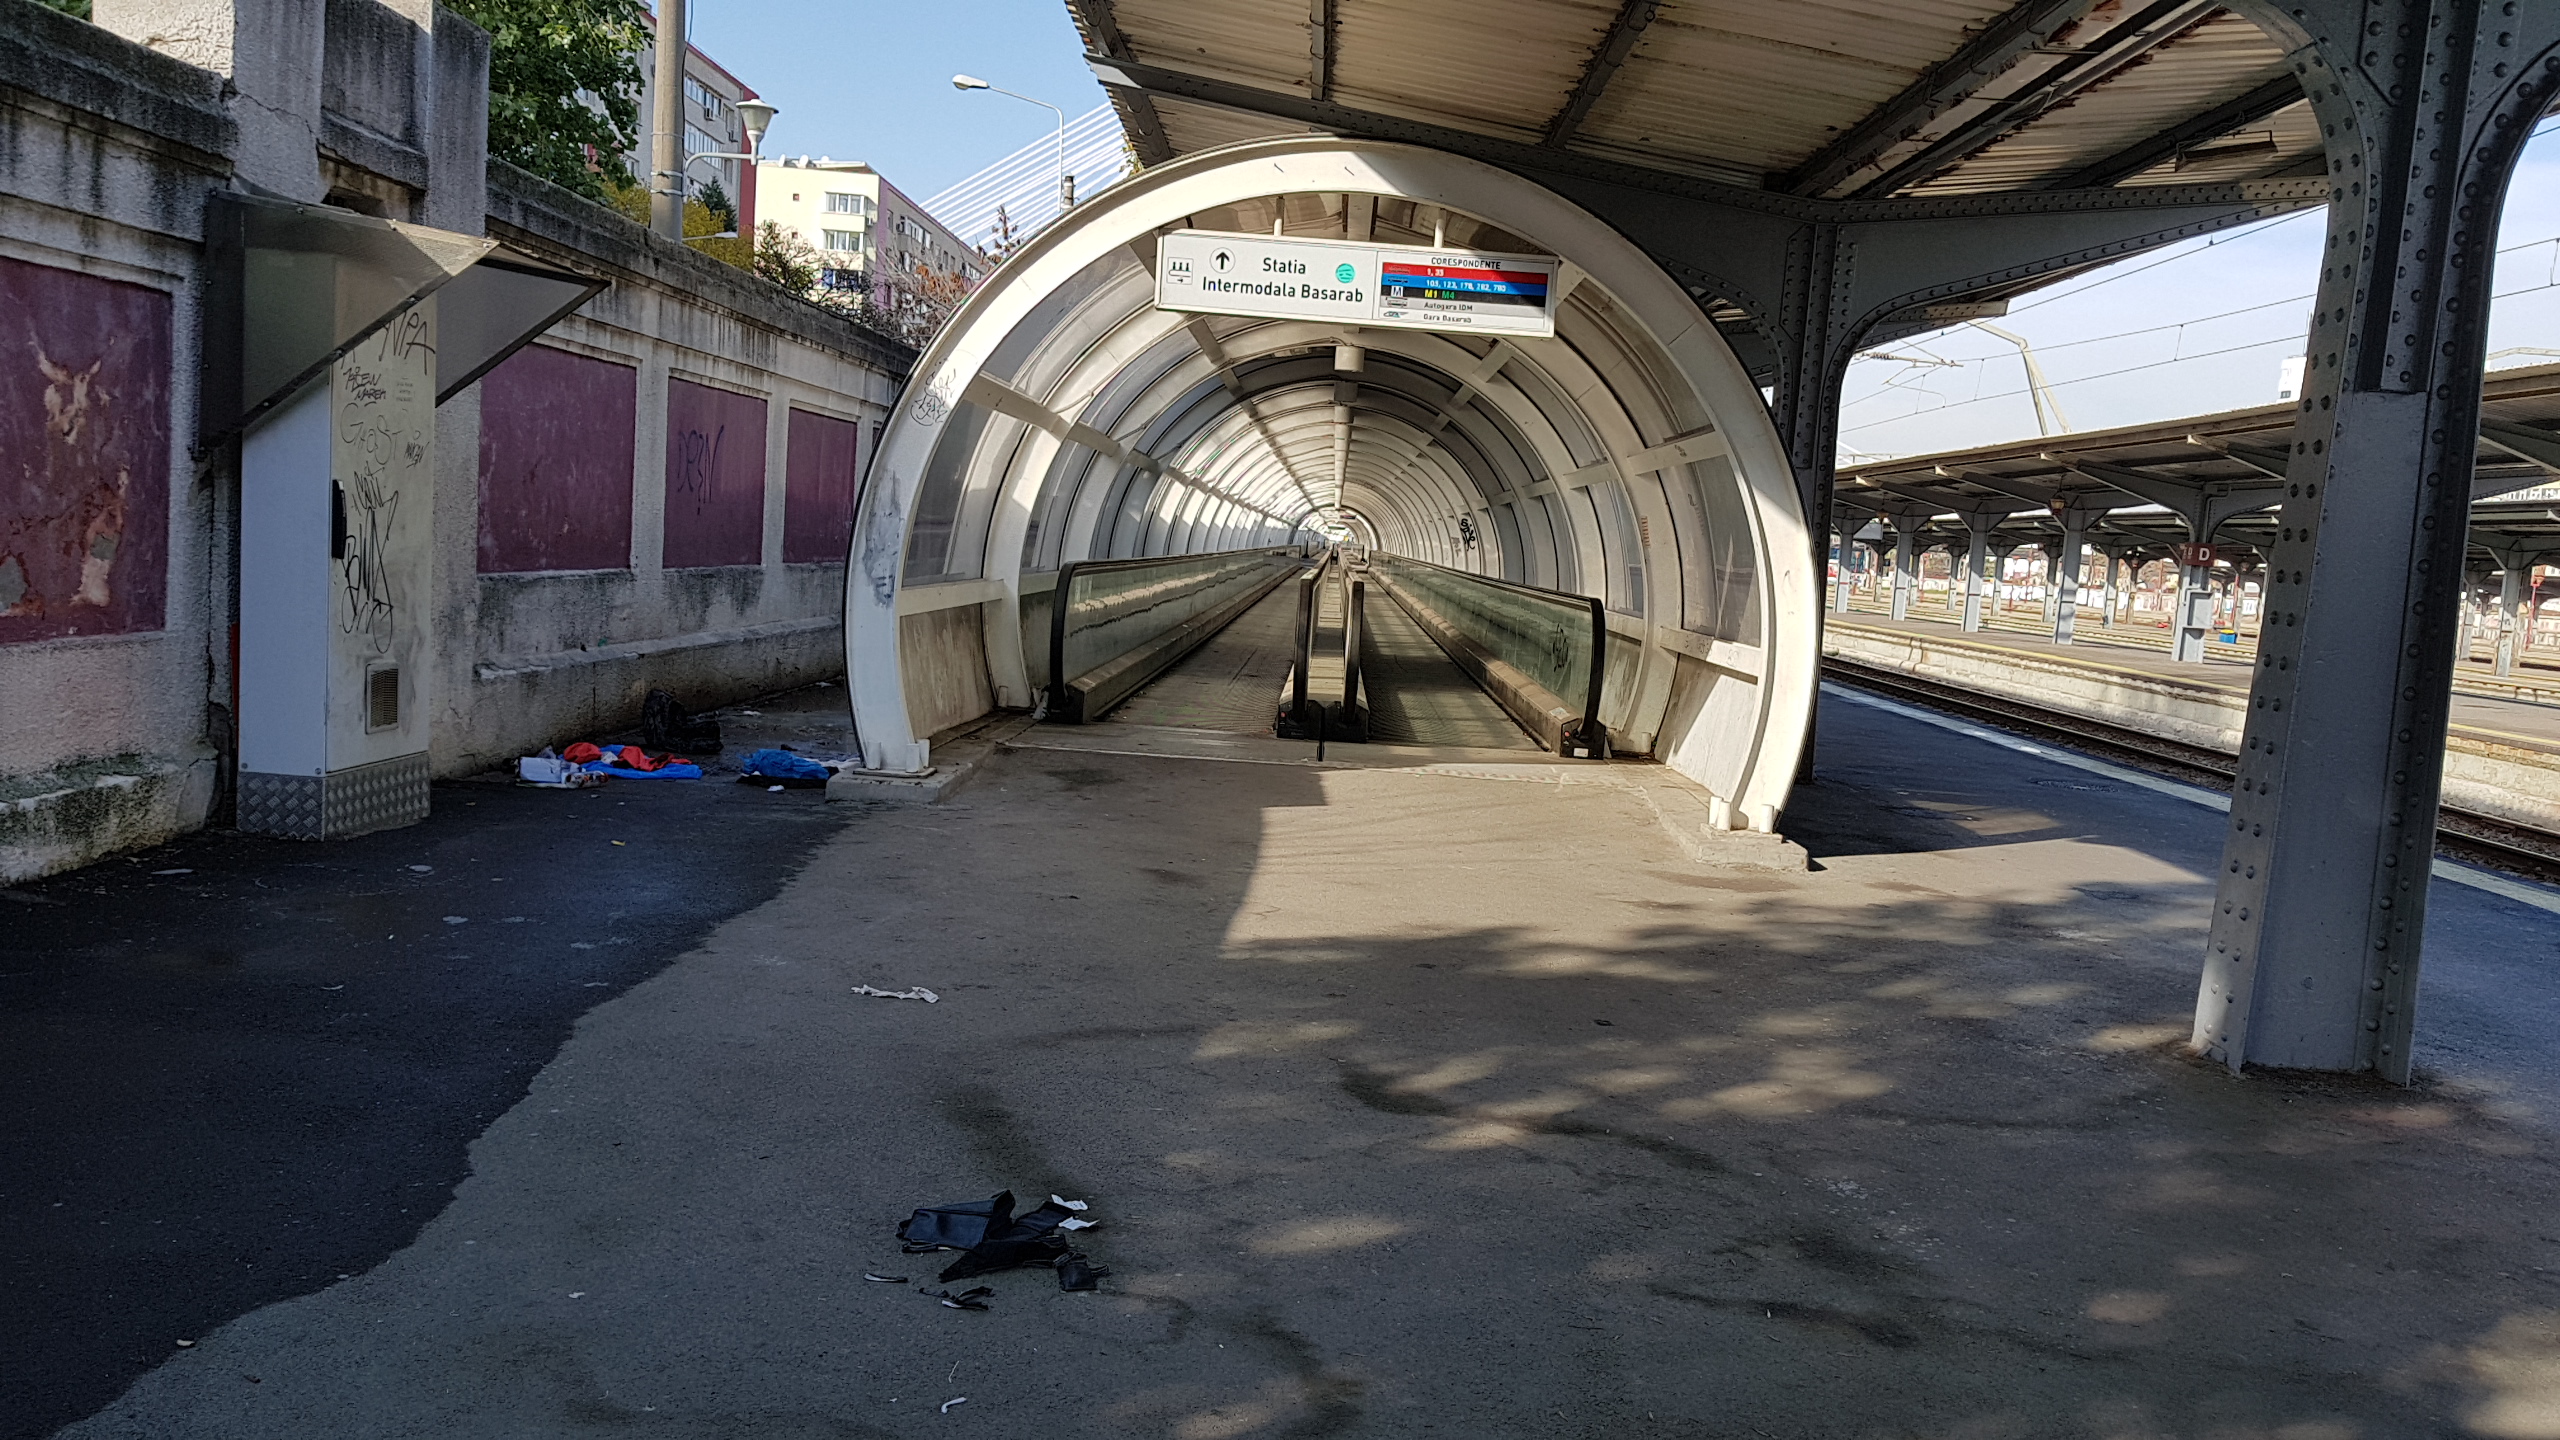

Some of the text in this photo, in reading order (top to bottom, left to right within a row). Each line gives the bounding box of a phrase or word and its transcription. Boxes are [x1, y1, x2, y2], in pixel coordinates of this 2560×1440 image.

[1262, 257, 1306, 275] Statia
[1431, 257, 1501, 269] CORESPONDENTE
[1202, 276, 1363, 303] Intermodala Basarab
[1425, 289, 1455, 299] M1 M4
[1424, 301, 1473, 311] Autogara IDM
[2199, 547, 2210, 561] D
